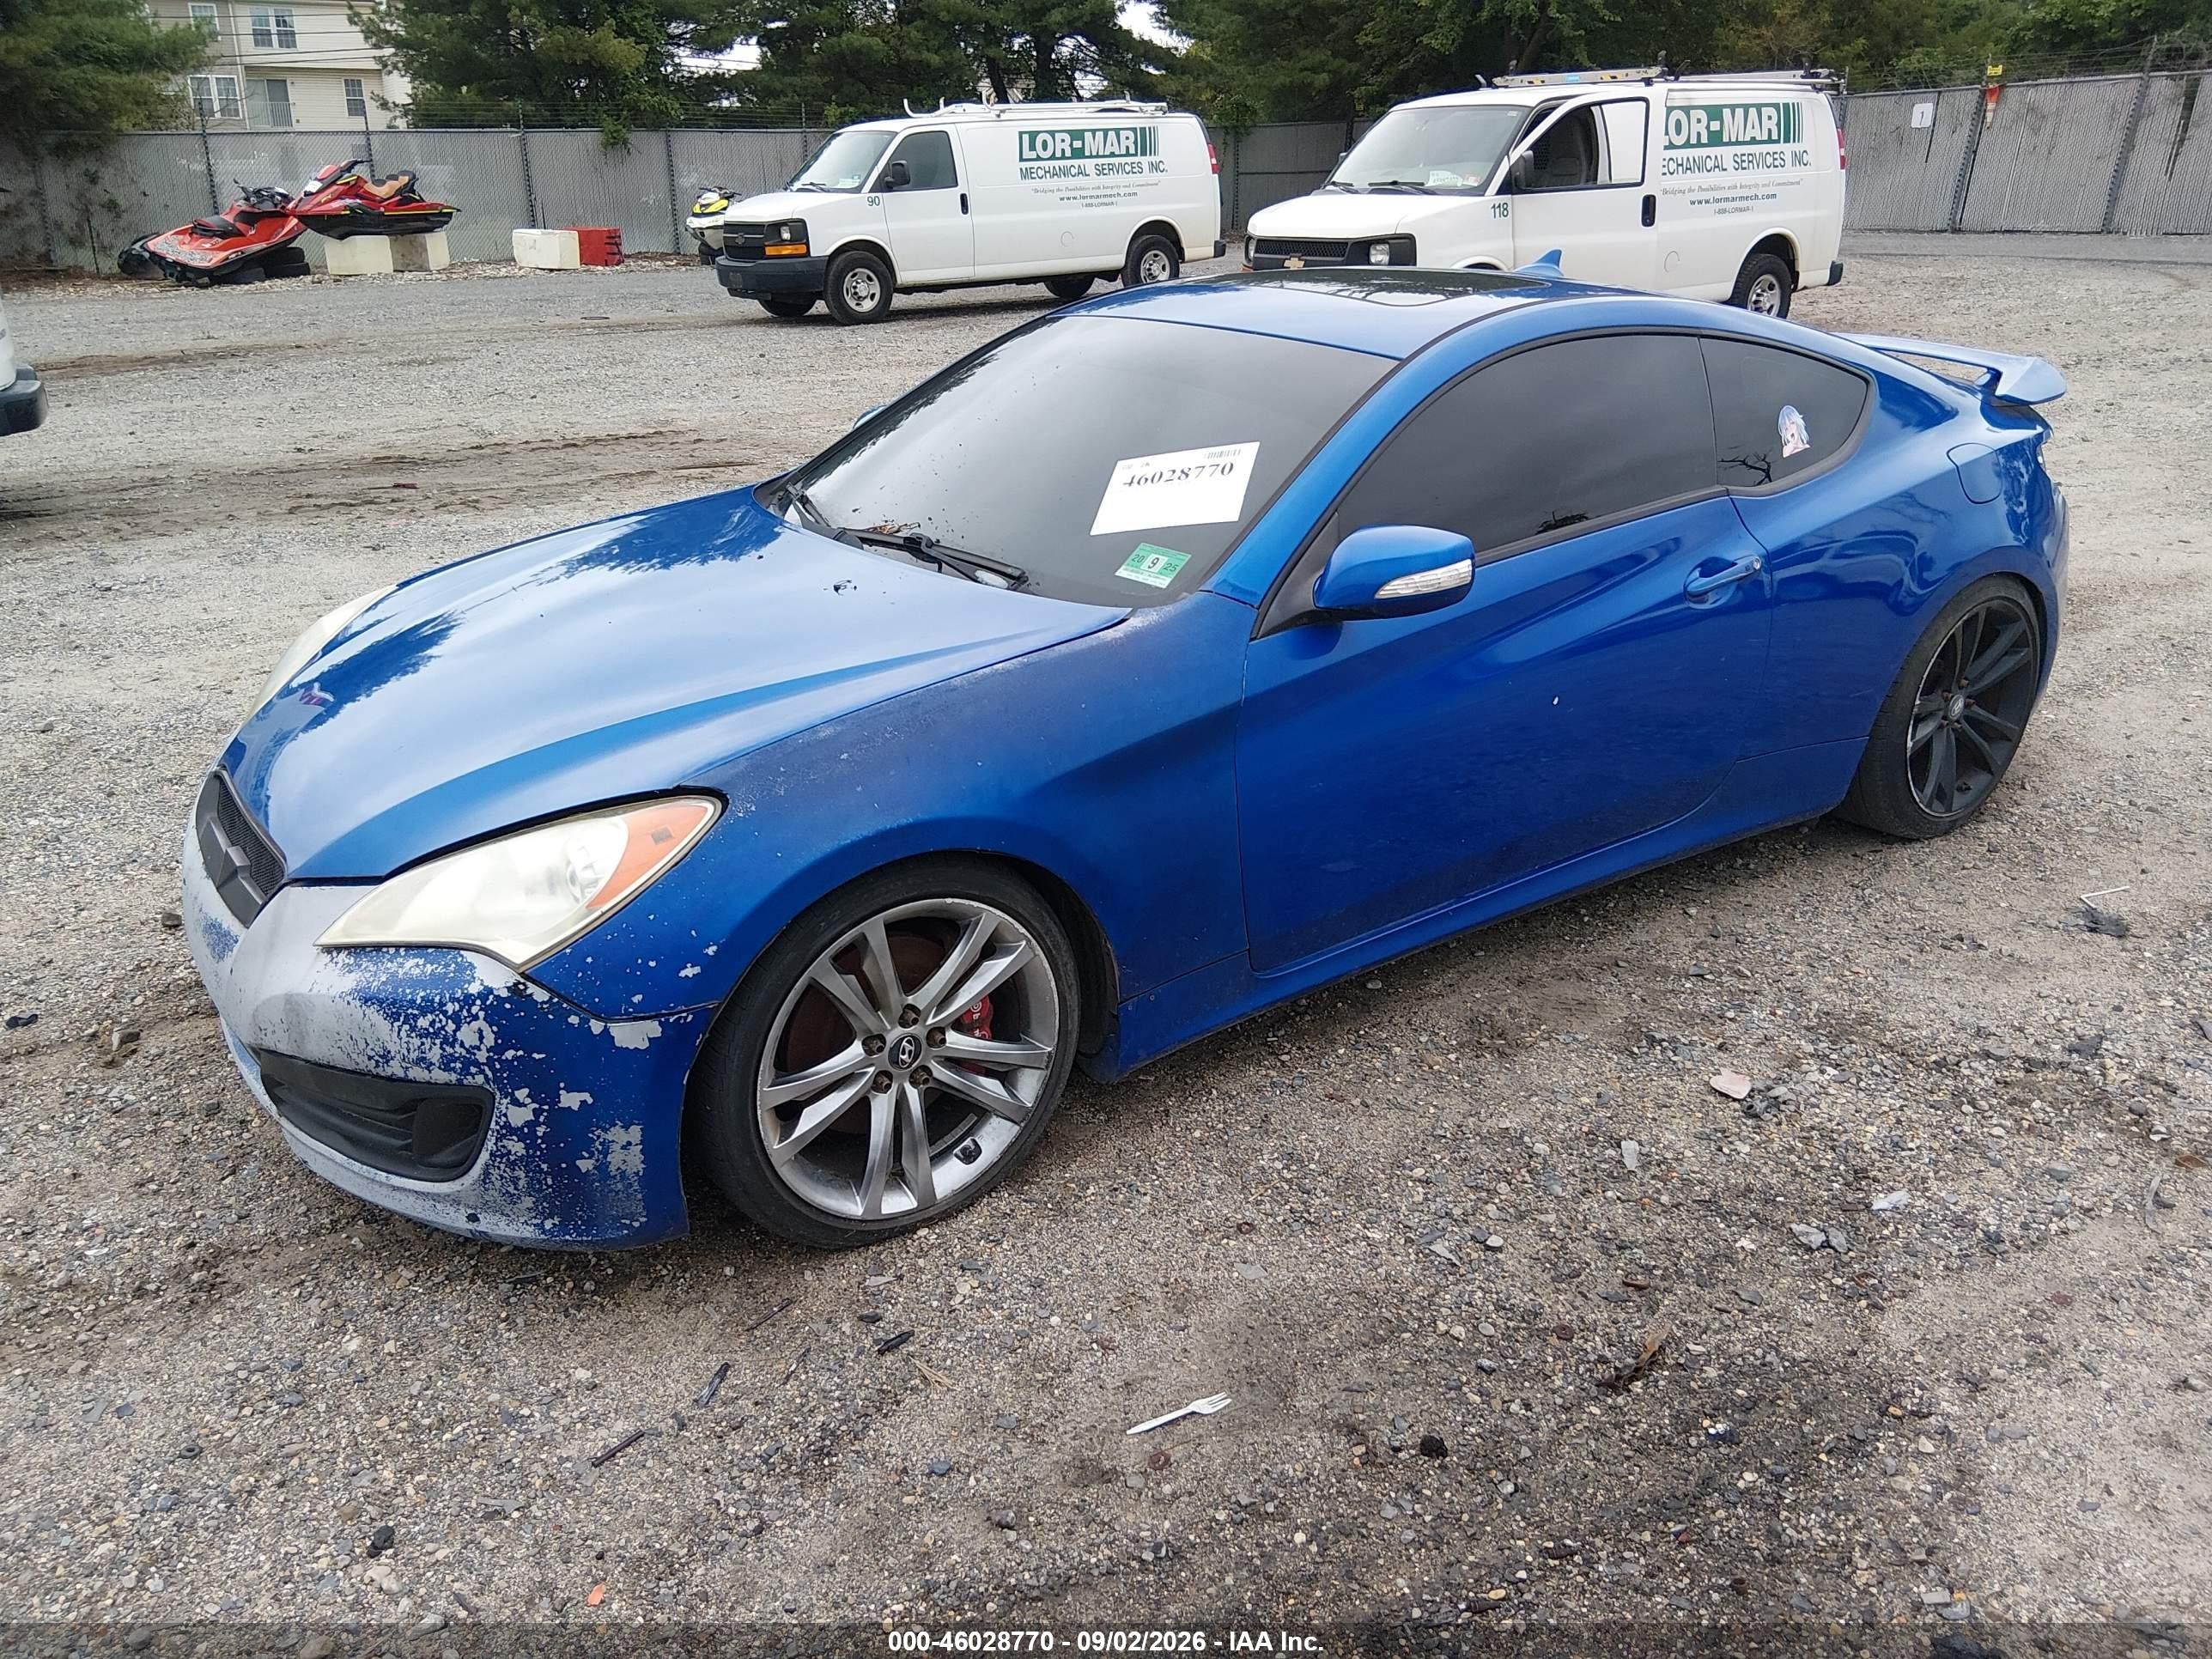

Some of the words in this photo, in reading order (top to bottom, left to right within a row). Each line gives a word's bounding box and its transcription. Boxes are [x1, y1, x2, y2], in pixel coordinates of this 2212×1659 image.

[1664, 106, 1779, 146] OR-MAR
[1021, 130, 1135, 159] LOR-MAR
[1019, 163, 1090, 180] MECHANICAL
[1094, 161, 1144, 177] SERVICES
[1148, 160, 1168, 173] INC.
[1662, 154, 1727, 176] ECHANICAL
[1733, 150, 1786, 171] SERVICES
[1791, 149, 1812, 167] INC.
[867, 196, 880, 206] 90
[1059, 191, 1138, 202] www.lormarmech.com
[1689, 192, 1777, 206] www.lormarmech.com
[1491, 203, 1509, 219] 118
[1122, 461, 1234, 487] 46028770
[1131, 554, 1146, 563] 20
[1147, 556, 1160, 569] 9
[1163, 562, 1180, 572] 25
